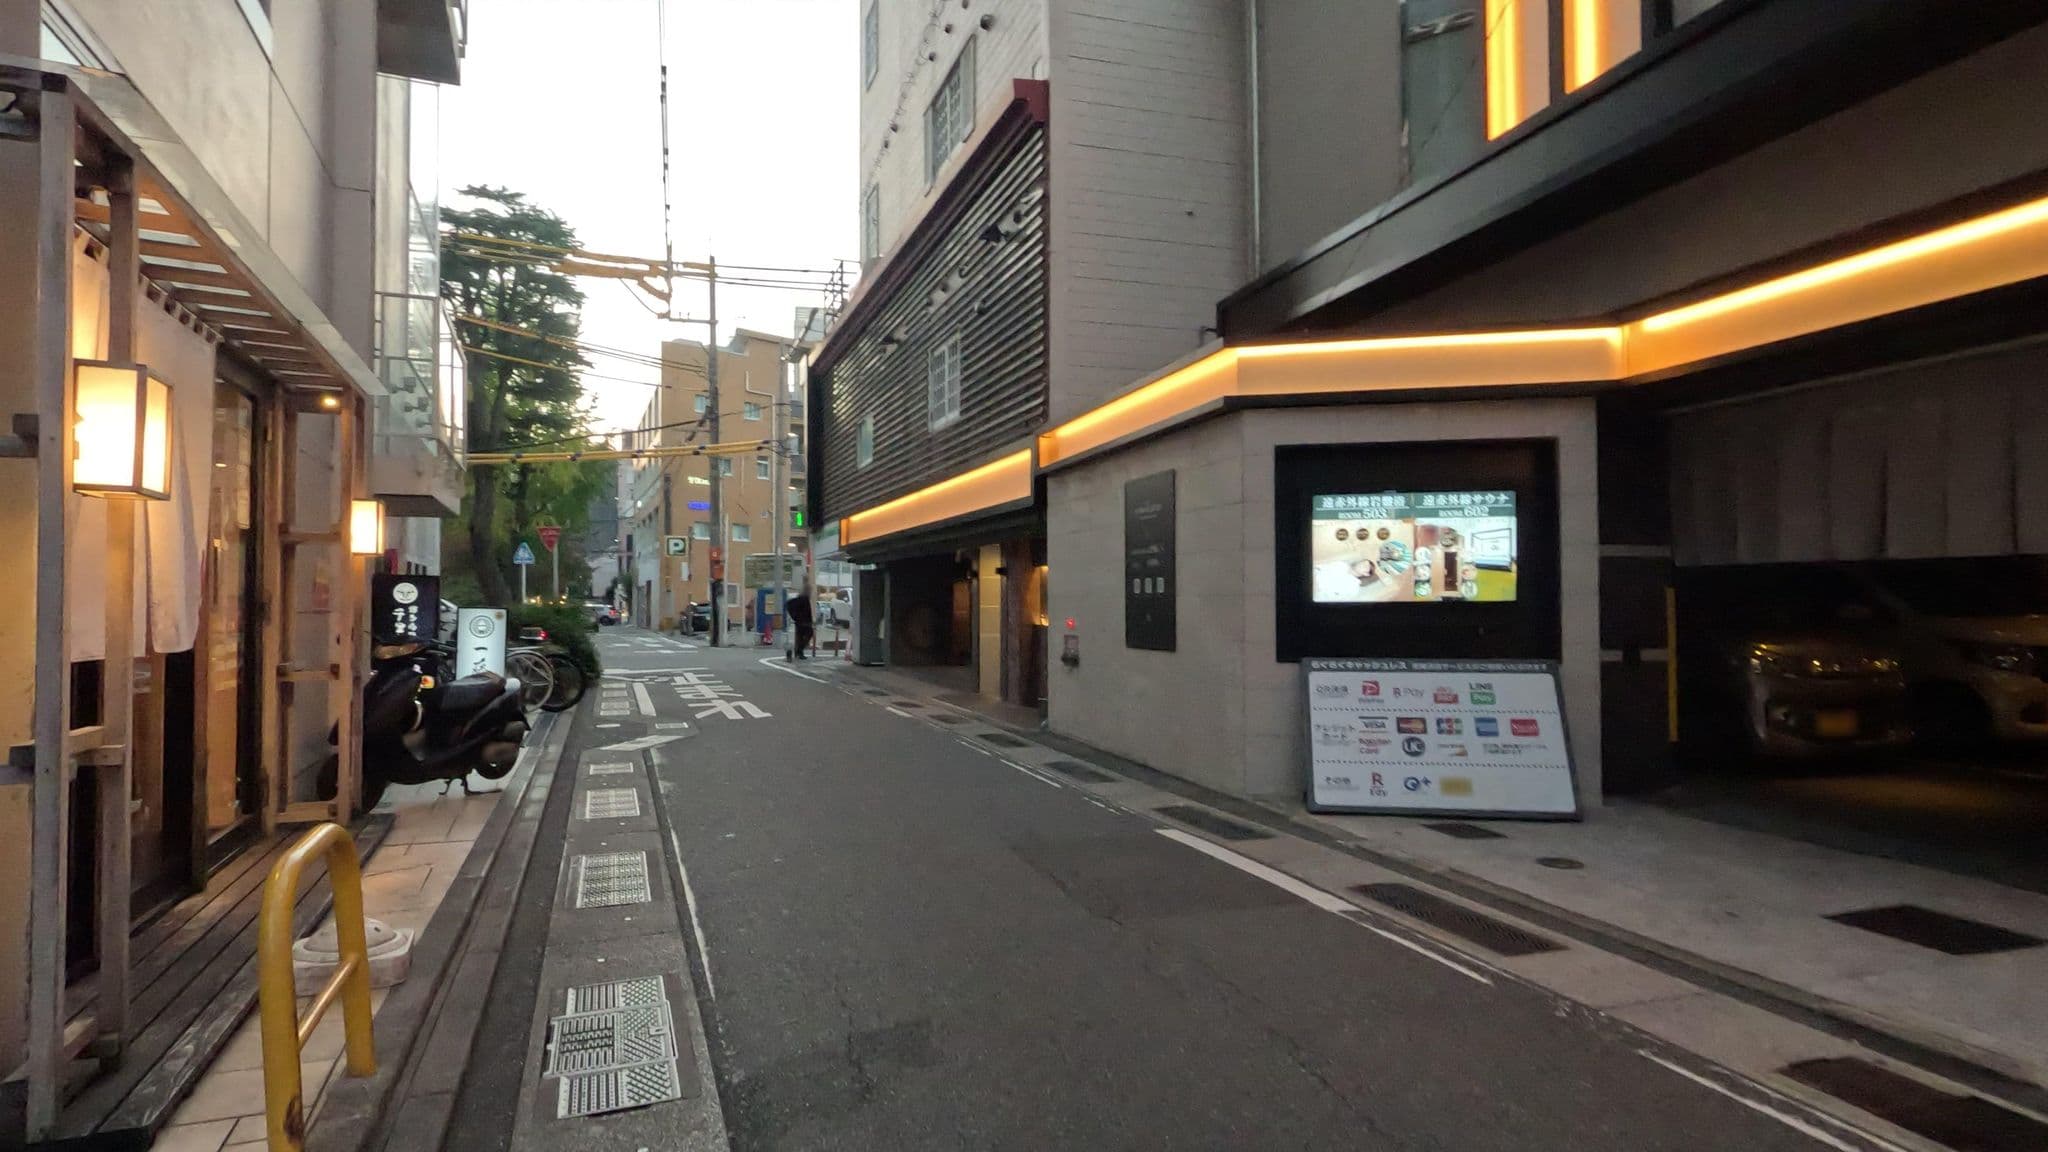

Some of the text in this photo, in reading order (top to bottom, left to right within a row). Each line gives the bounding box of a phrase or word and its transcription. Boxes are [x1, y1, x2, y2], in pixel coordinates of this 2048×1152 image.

[669, 538, 686, 555] P
[1468, 682, 1493, 691] LINE
[670, 671, 774, 720] 止まれ
[1362, 720, 1387, 729] VISA
[1371, 771, 1385, 786] R
